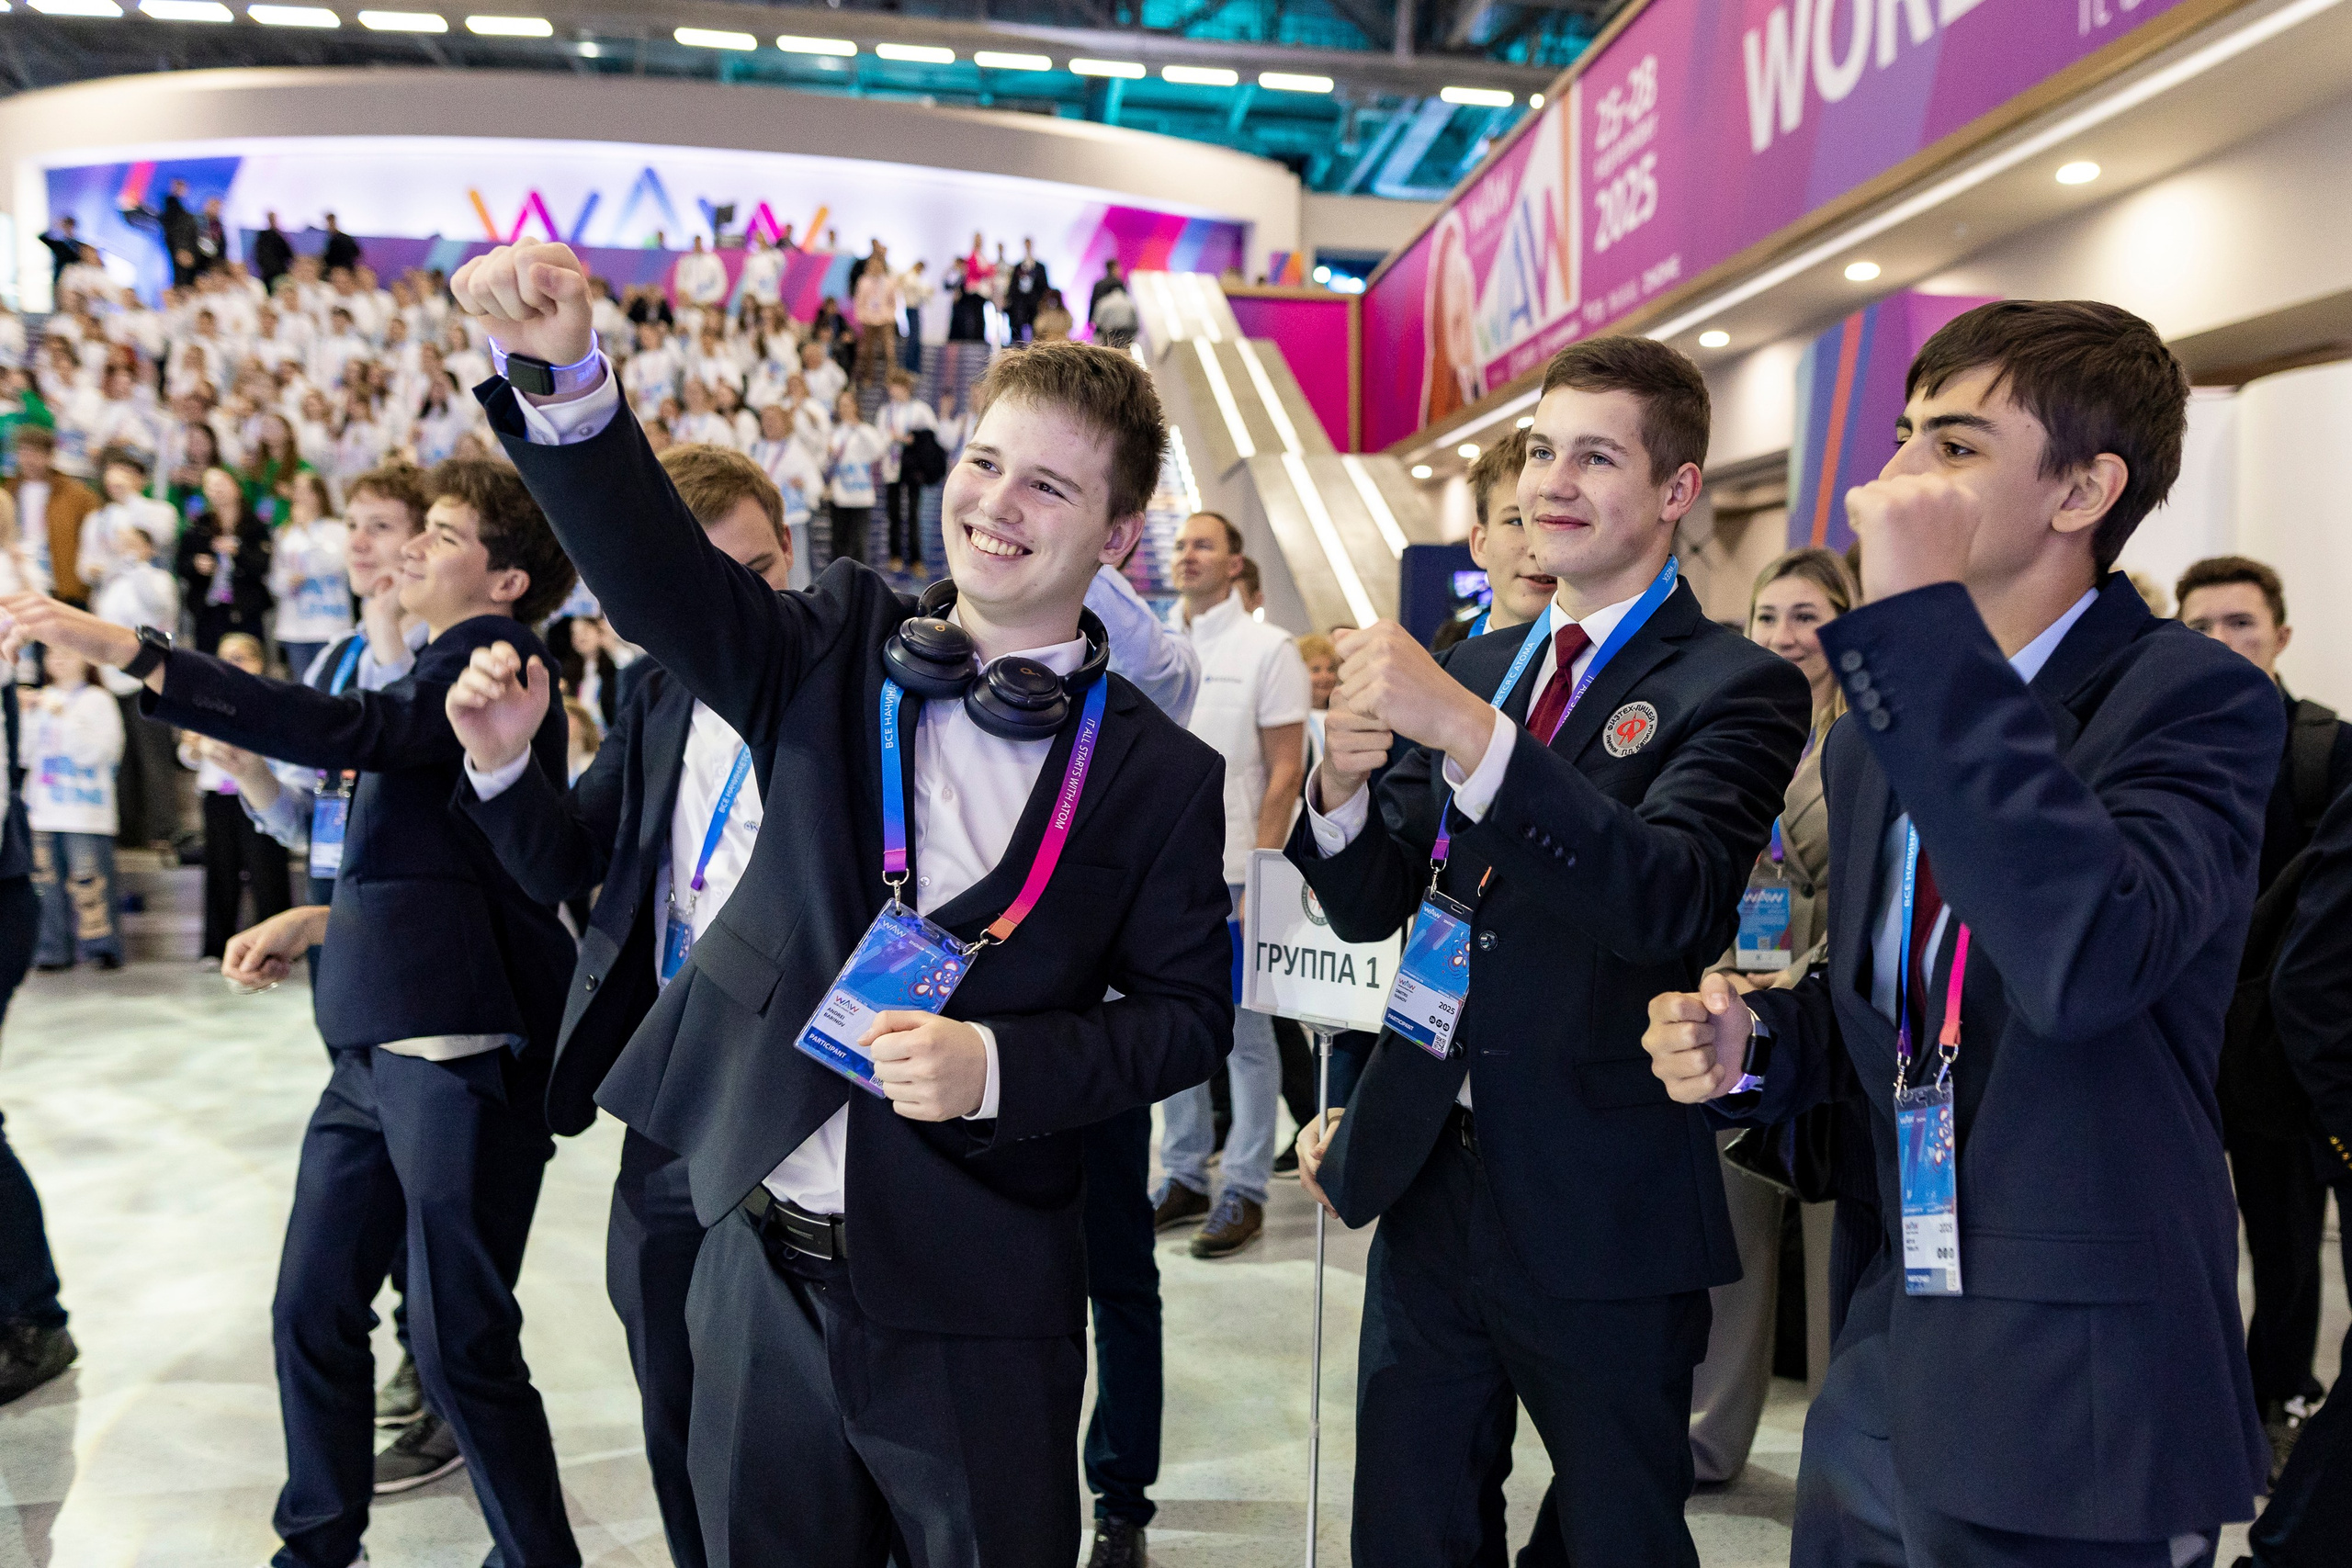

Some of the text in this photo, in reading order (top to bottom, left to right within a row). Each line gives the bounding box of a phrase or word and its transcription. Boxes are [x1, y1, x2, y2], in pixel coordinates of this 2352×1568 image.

[1595, 53, 1658, 152] 25-28
[1594, 153, 1659, 254] 2025
[1515, 642, 1535, 672] АТОМА
[885, 728, 894, 749] ВСЕ
[1054, 717, 1096, 830] IT ALL STARTS WITH ATOM
[718, 798, 730, 814] ВСЕ
[1423, 905, 1442, 919] WAW
[882, 919, 907, 938] WAW
[1257, 942, 1380, 989] ГРУППА 1
[1398, 976, 1417, 991] WAW
[835, 995, 860, 1013] WAW
[1438, 1000, 1455, 1015] 2025
[823, 1012, 845, 1028] BARINOV
[827, 1007, 845, 1021] ANDREI
[808, 1032, 847, 1059] PARTICIPANT
